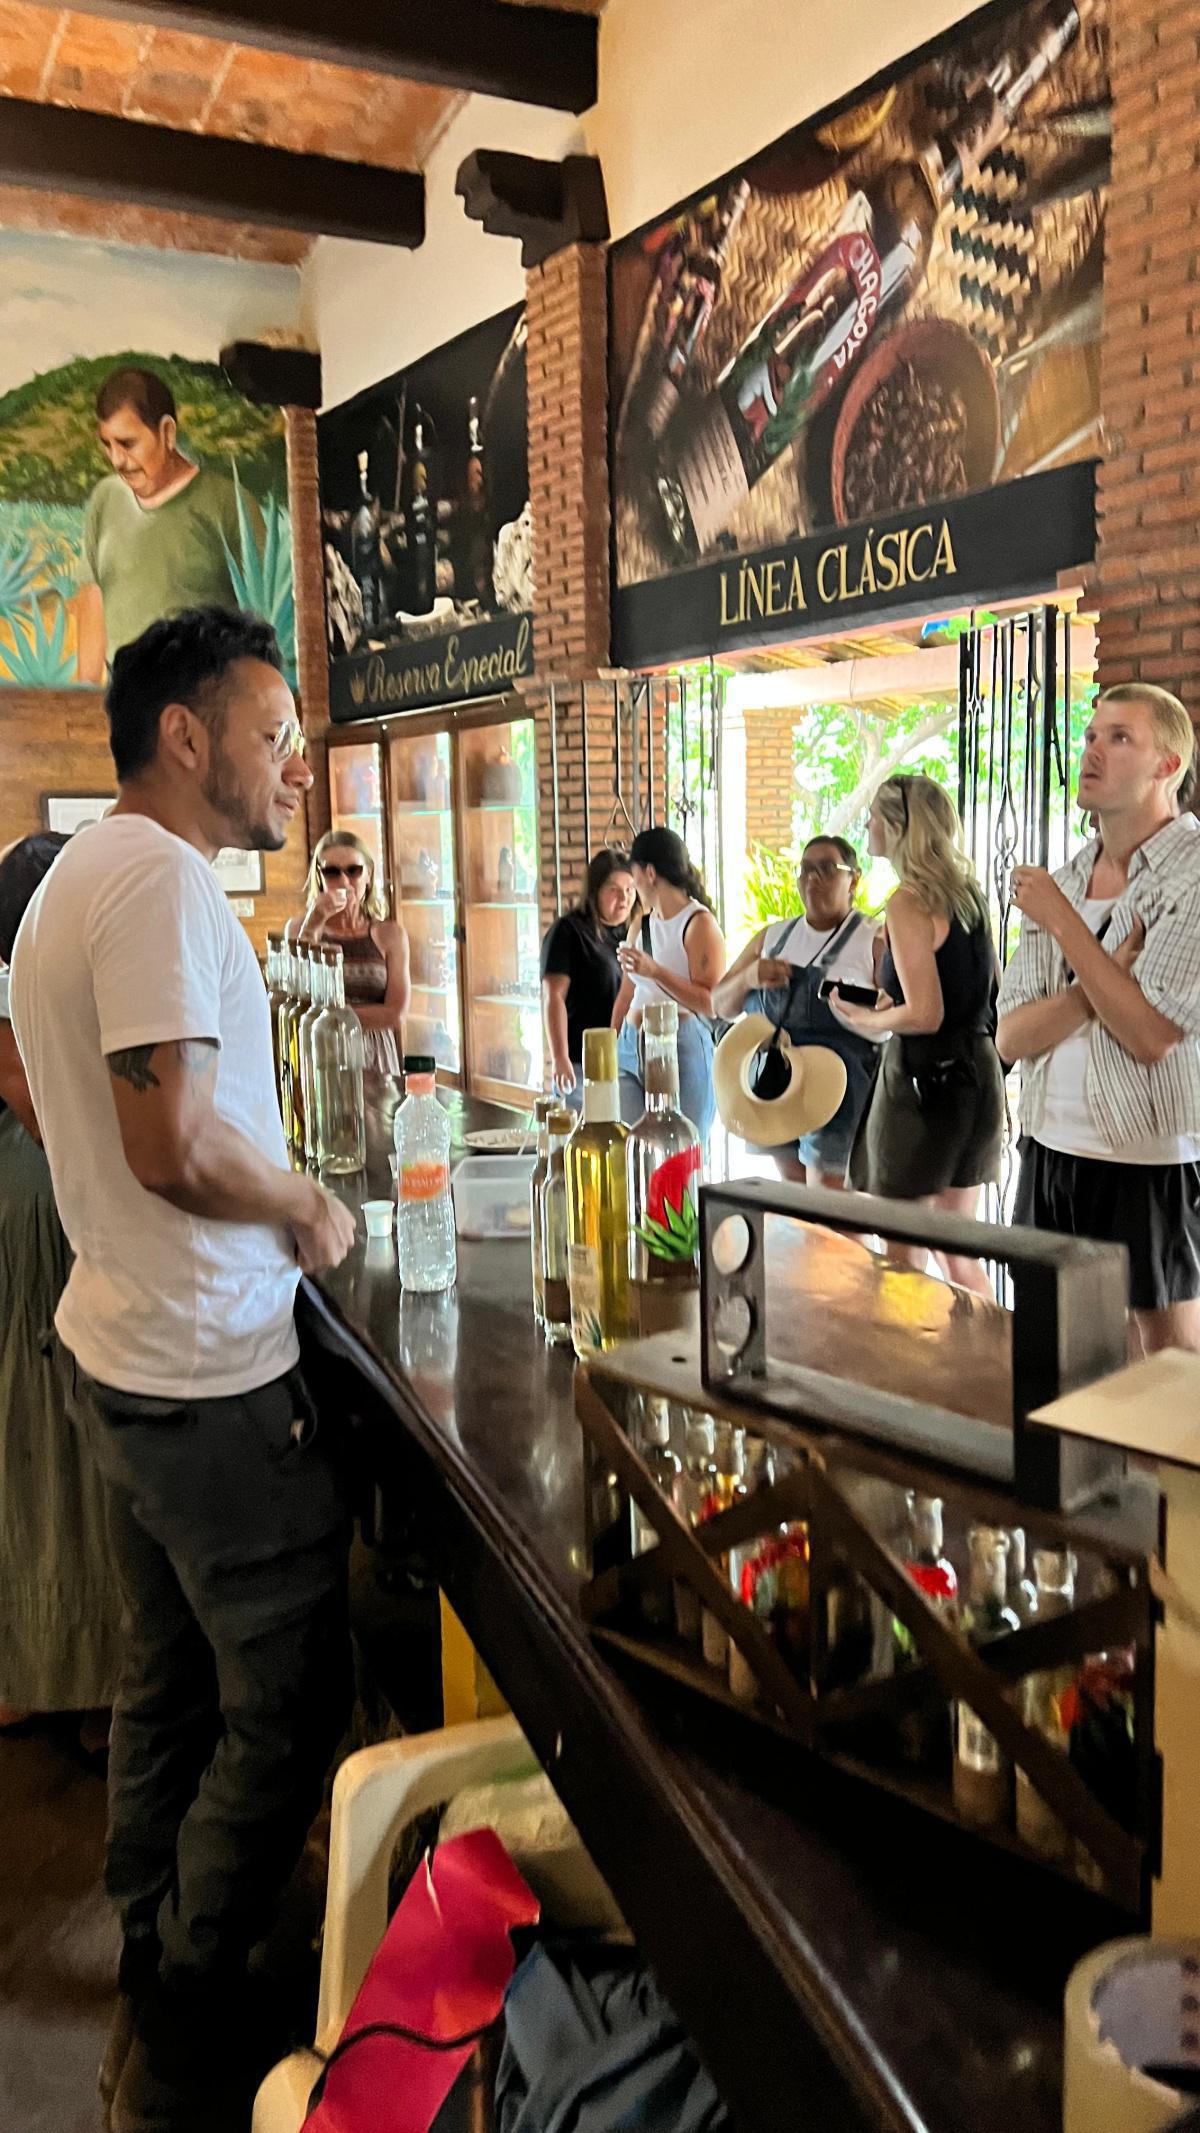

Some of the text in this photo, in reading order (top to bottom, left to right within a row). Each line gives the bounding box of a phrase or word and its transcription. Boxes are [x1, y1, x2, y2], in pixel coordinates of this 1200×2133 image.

[833, 238, 879, 369] CHAGOYA
[720, 518, 957, 626] LÍNEA CLÁSICA
[367, 616, 529, 702] Reserva Especial
